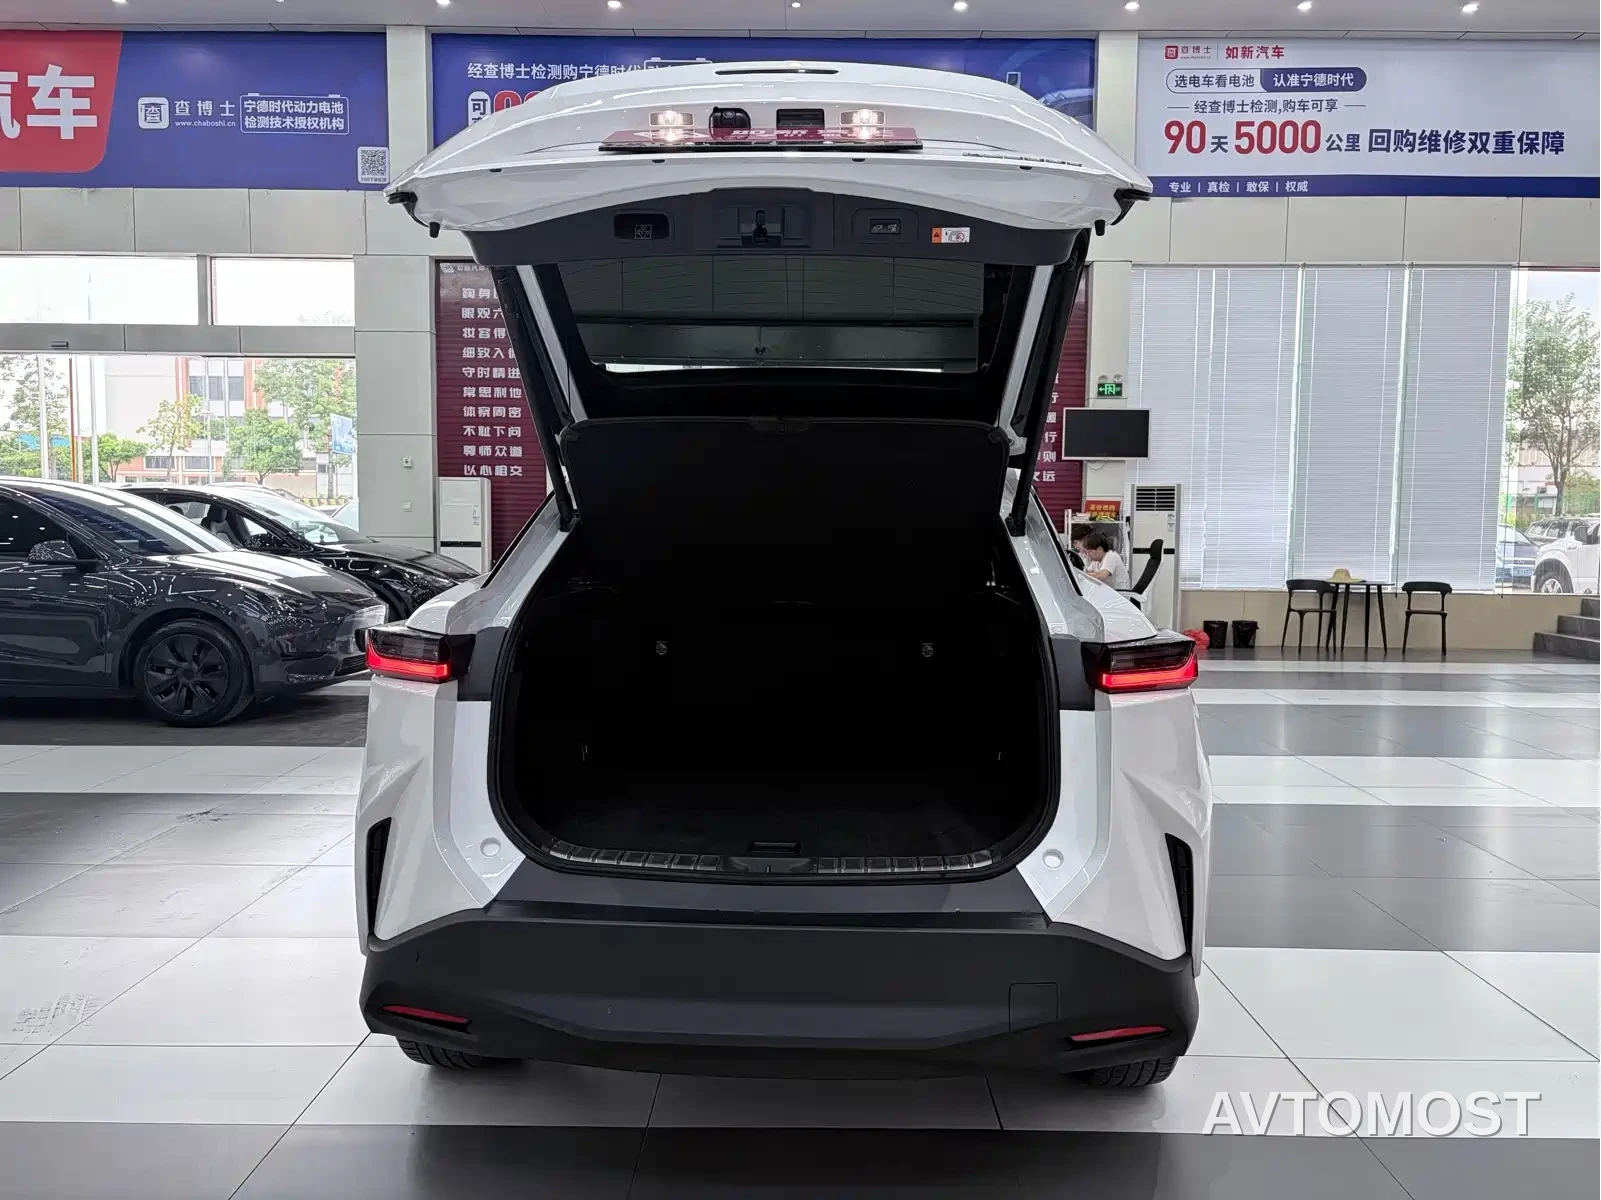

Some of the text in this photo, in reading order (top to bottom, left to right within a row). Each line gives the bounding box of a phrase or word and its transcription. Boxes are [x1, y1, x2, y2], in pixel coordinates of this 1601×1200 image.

[1225, 45, 1285, 60] 如新汽车
[1175, 73, 1354, 88] 选电车看电池 认准宁德时代
[174, 100, 235, 117] 查博士
[243, 99, 344, 114] 宁德时代动力电池
[1193, 99, 1338, 114] 经查博士检测,购车可享
[174, 119, 236, 127] www.chaboshi.cn
[244, 115, 345, 130] 检测技术授权机构
[1164, 120, 1207, 155] 90
[1234, 120, 1322, 155] 5000
[1325, 133, 1361, 153] 公里
[1368, 128, 1566, 155] 回购维修双重保障
[1169, 181, 1309, 193] 专业 真检 敢保 权威
[462, 386, 523, 399] 常思利他
[462, 406, 522, 419] 体察周密
[462, 425, 522, 438] 不耻下问
[463, 464, 523, 477] 以心相交
